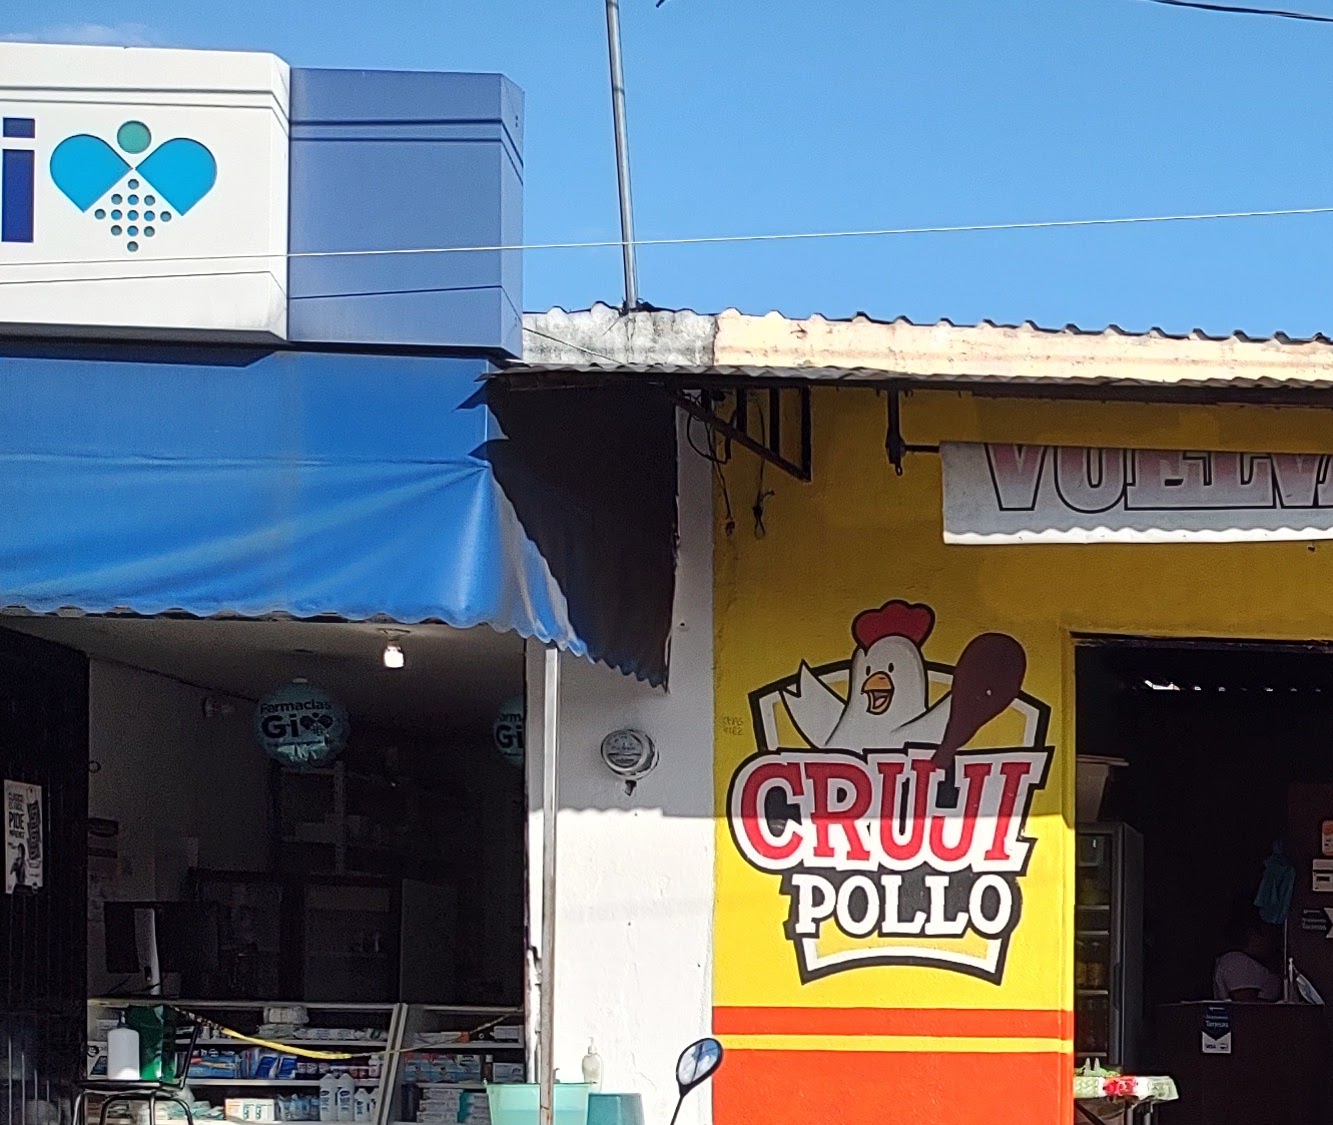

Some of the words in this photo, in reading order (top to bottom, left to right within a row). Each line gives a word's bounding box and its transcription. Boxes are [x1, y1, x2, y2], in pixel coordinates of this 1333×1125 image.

[261, 713, 299, 739] Gi
[739, 757, 1032, 864] CRUJI
[791, 872, 1013, 935] POLLO
